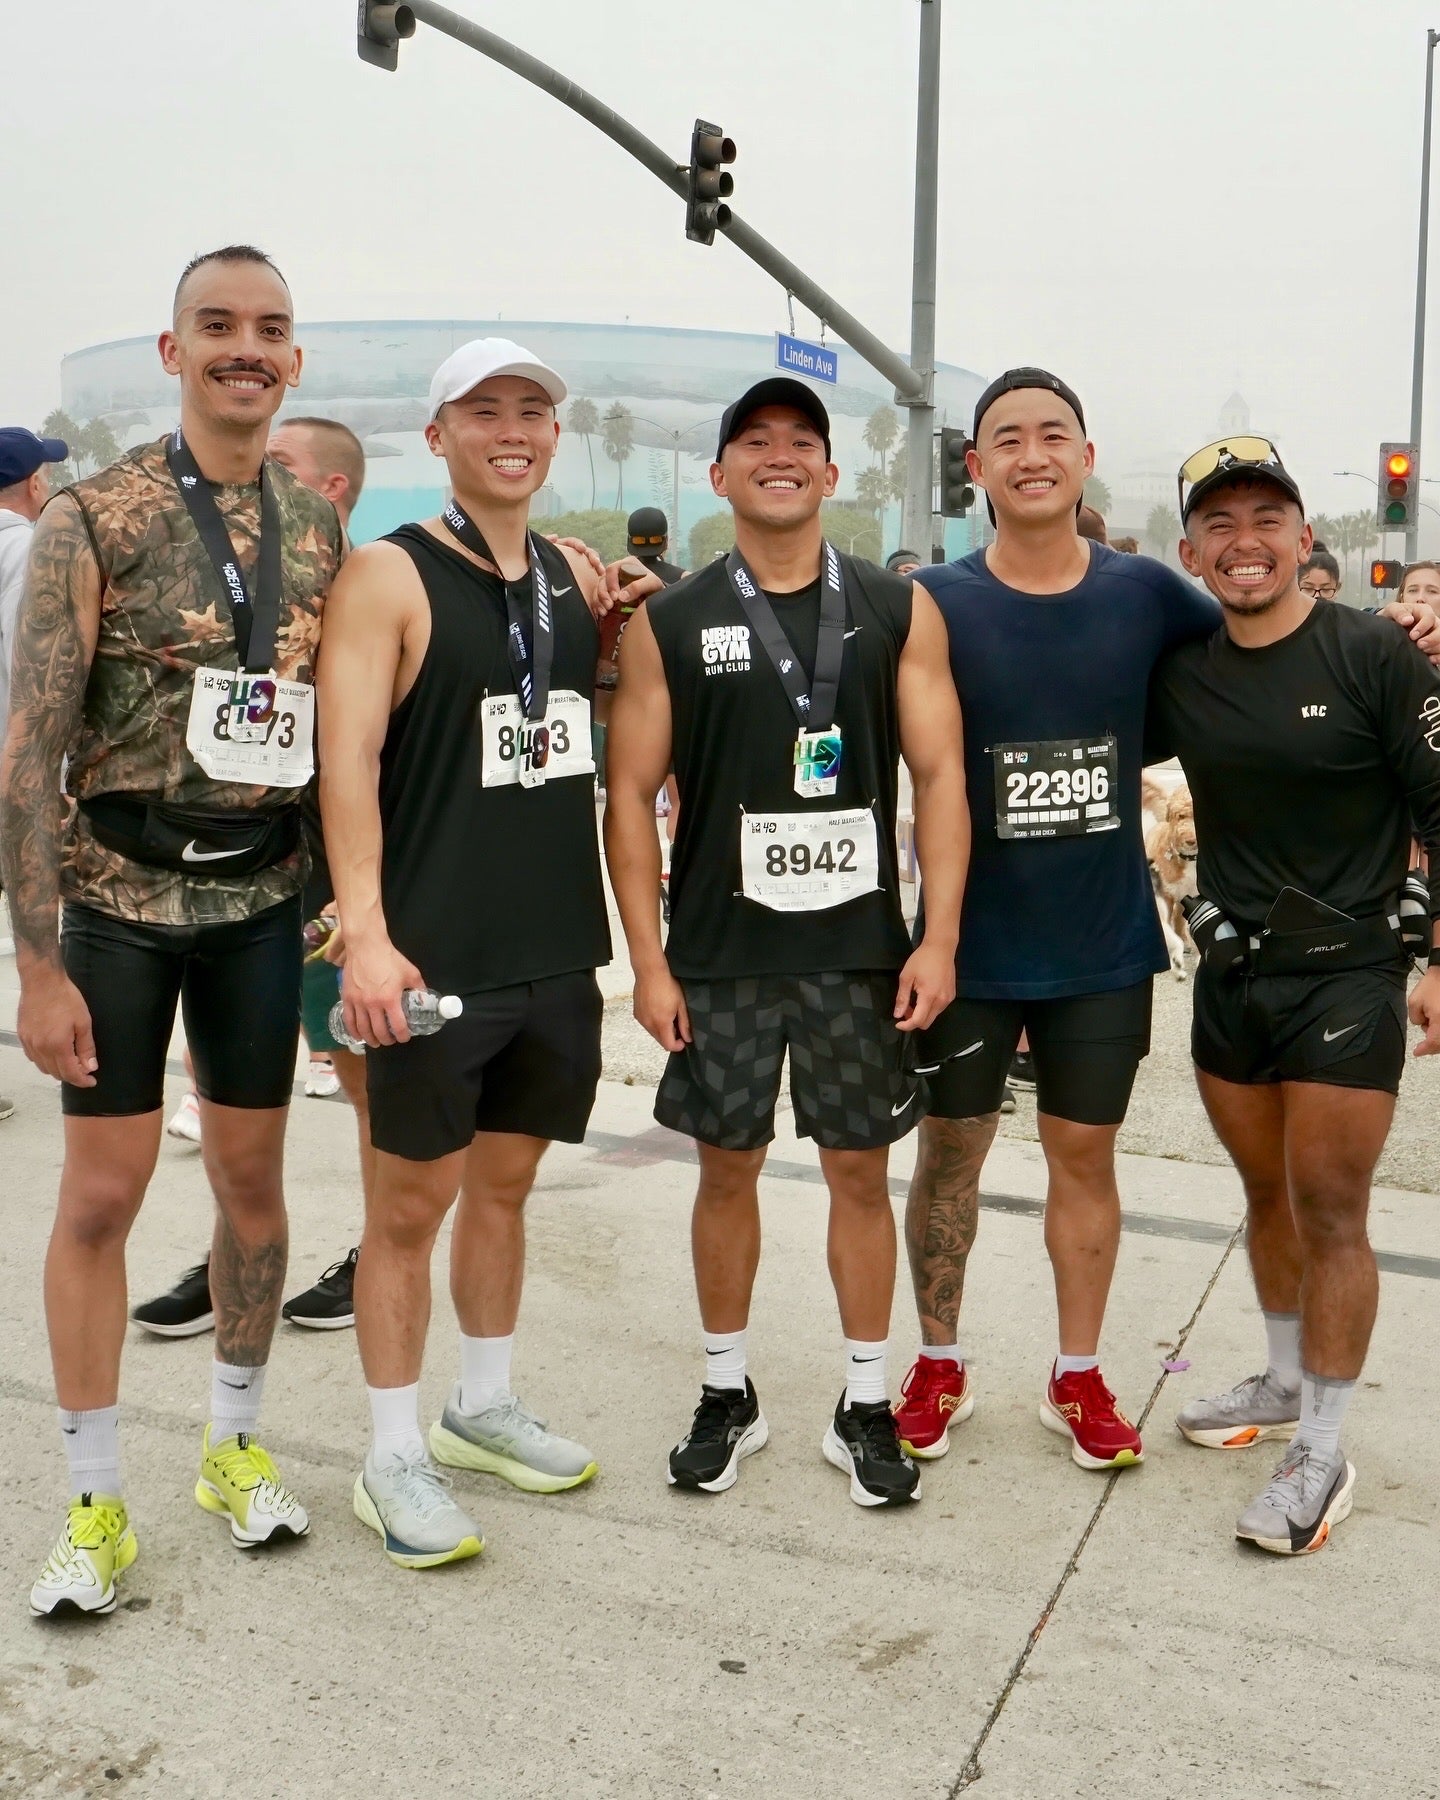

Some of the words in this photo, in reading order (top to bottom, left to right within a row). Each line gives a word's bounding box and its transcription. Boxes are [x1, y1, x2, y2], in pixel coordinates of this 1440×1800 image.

[784, 343, 813, 370] Linden
[815, 355, 833, 377] Ave
[701, 625, 750, 646] NBHD
[702, 641, 751, 664] GYM
[704, 663, 723, 676] RUN
[726, 661, 751, 673] CLUB
[213, 703, 296, 748] 873
[1301, 705, 1328, 718] KRC
[498, 719, 570, 761] 83
[1006, 766, 1109, 808] 22396
[765, 838, 858, 877] 8942
